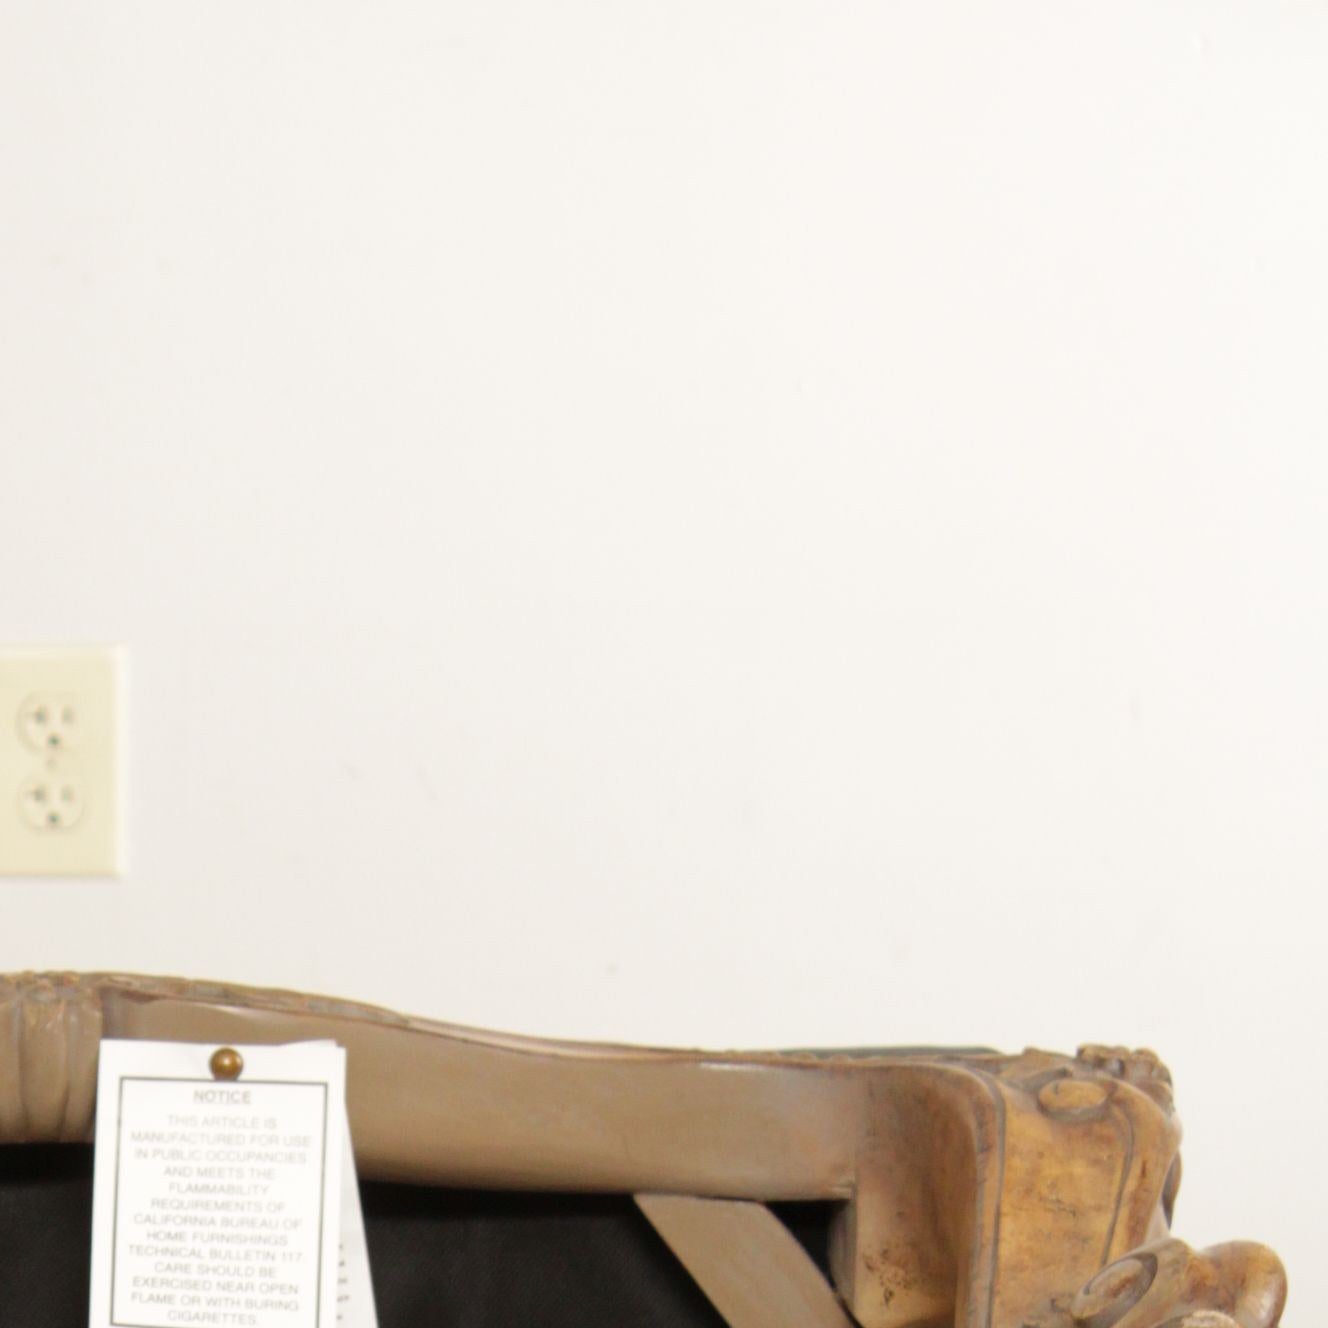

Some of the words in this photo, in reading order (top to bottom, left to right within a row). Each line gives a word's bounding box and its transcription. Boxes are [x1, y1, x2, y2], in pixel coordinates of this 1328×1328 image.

[193, 1090, 252, 1105] NOTICE
[167, 1114, 198, 1127] THIS
[201, 1116, 259, 1129] ARTICLE
[264, 1117, 278, 1129] IS
[130, 1131, 245, 1146] MANUFACTURED
[250, 1134, 279, 1146] FOR
[284, 1135, 312, 1148] USE
[134, 1148, 148, 1160] IN
[152, 1149, 202, 1161] PUBLIC
[205, 1150, 307, 1164] OCCUPANCIES
[164, 1166, 193, 1178] AND
[196, 1166, 244, 1179] MEETS
[248, 1168, 275, 1180] THE
[168, 1182, 270, 1195] FLAMMABILITY
[150, 1198, 263, 1213] REQUIREMENTS
[266, 1201, 286, 1213] OF
[133, 1213, 216, 1227] CALIFORNIA
[220, 1216, 279, 1229] BUREAU
[282, 1218, 303, 1231] OF
[146, 1230, 187, 1242] HOME
[192, 1232, 288, 1247] FURNISHINGS
[128, 1244, 204, 1259] TECHNICAL
[209, 1248, 276, 1262] BULLETIN
[154, 1262, 192, 1274] CARE
[197, 1264, 255, 1278] SHOULD
[259, 1266, 279, 1279] BE
[132, 1276, 212, 1292] EXERCISED
[216, 1280, 255, 1293] NEAR
[259, 1283, 299, 1295] OPEN
[130, 1291, 177, 1305] FLAME
[180, 1294, 201, 1306] OR
[205, 1295, 241, 1307] WITH
[244, 1298, 300, 1312] BURING
